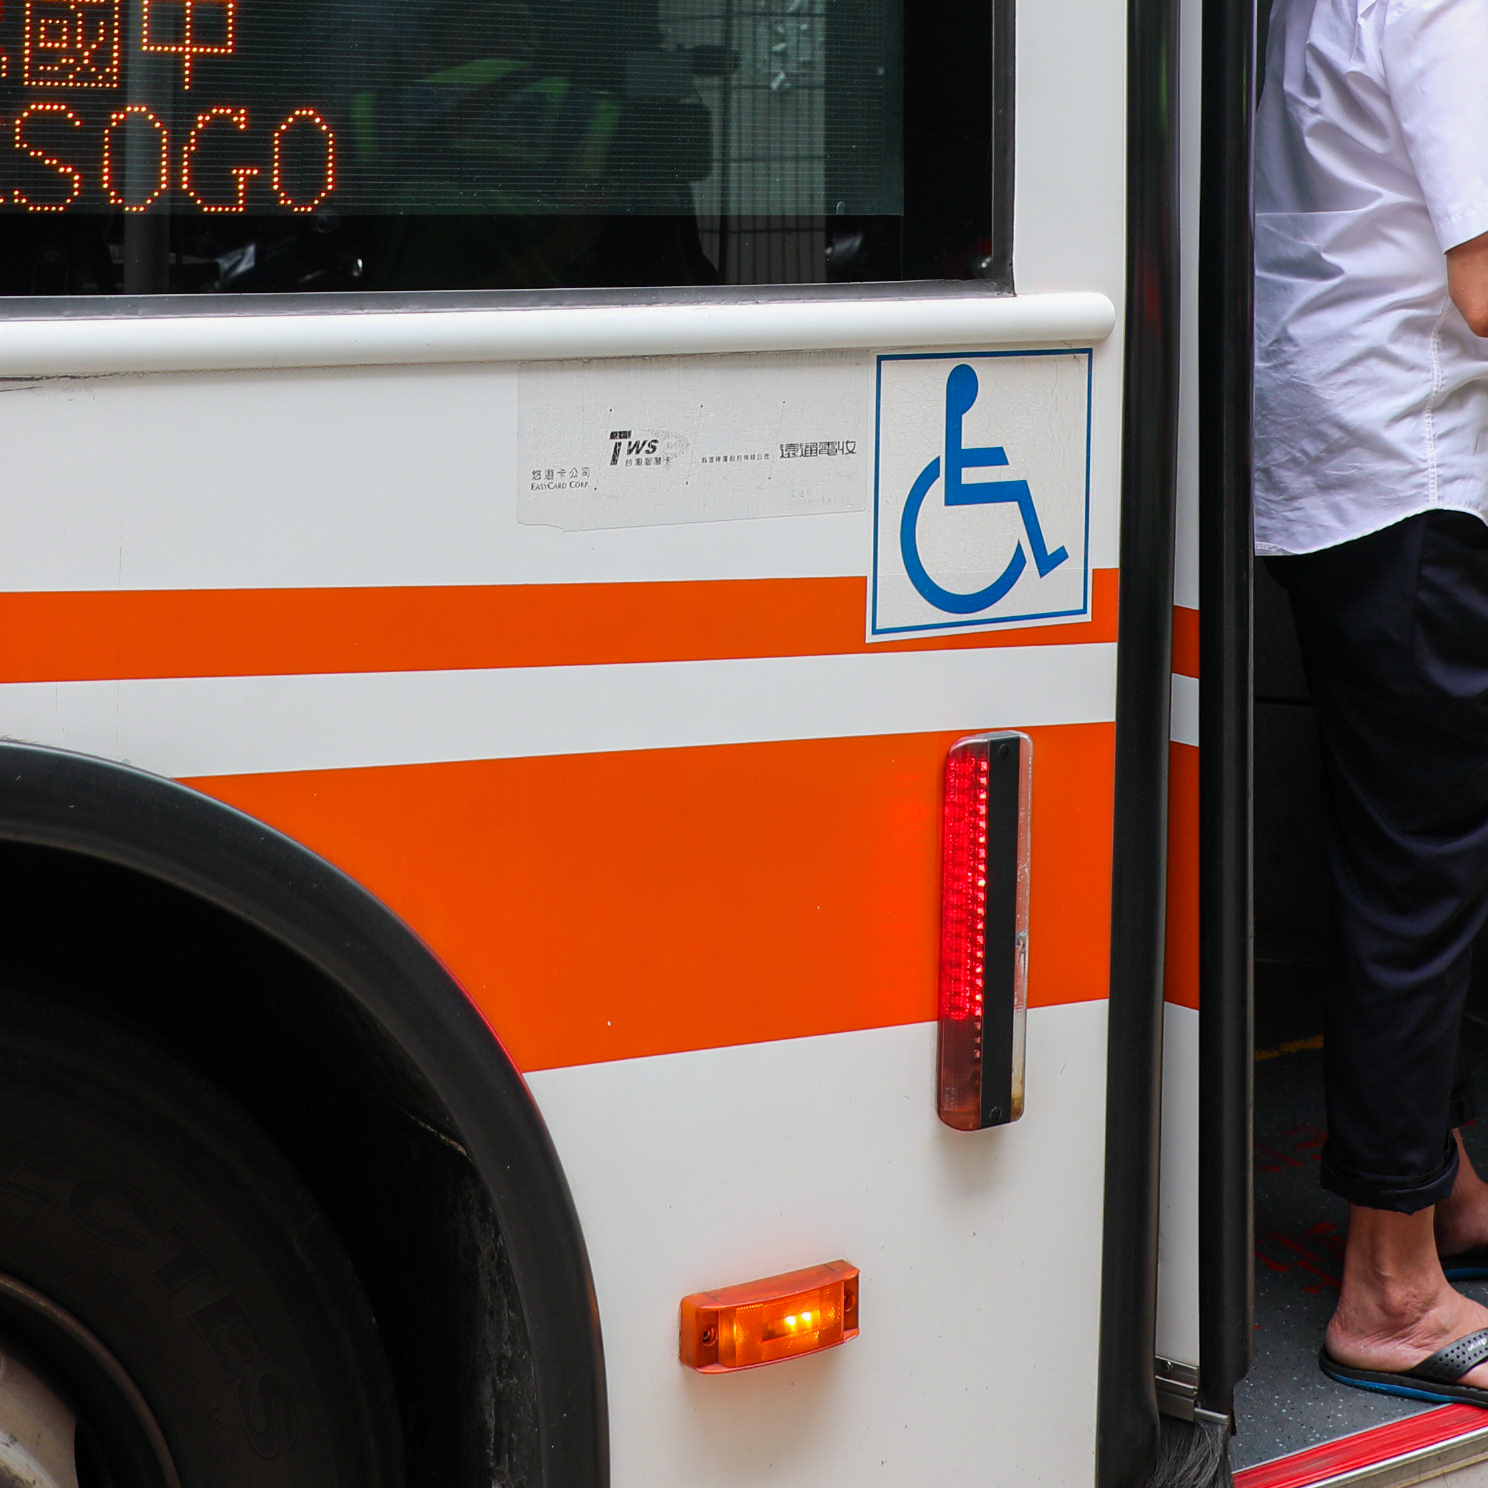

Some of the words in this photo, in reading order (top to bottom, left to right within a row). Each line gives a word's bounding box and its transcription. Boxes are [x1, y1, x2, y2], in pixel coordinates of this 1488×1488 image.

[609, 430, 659, 466] TWS
[779, 439, 857, 459] 遠通電收
[531, 466, 591, 482] 悠遊卡公司
